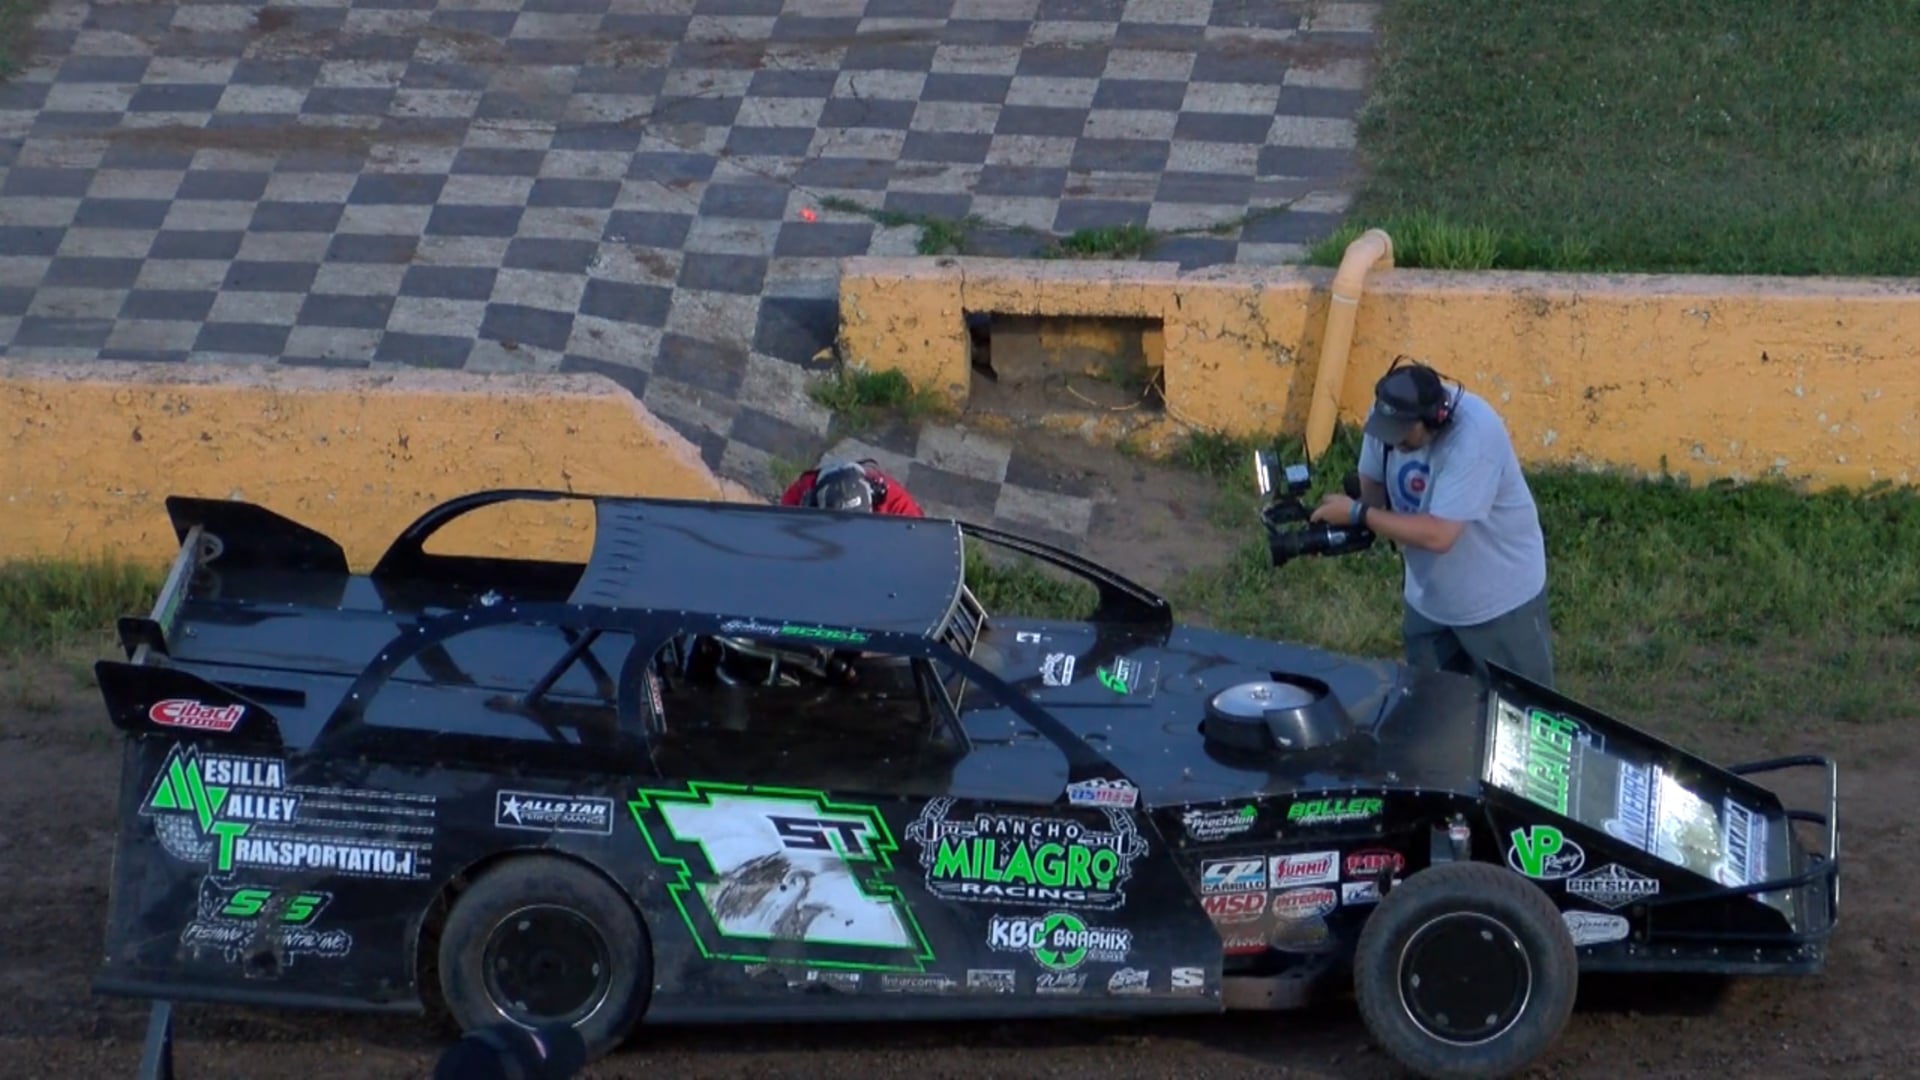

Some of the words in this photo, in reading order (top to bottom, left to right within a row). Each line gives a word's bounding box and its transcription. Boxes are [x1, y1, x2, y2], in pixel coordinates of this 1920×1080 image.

[1287, 799, 1382, 819] BOLLER
[979, 818, 1079, 840] RANCHO
[932, 837, 1119, 889] MILAGRO
[1511, 826, 1564, 879] VP
[961, 882, 1086, 900] RACING
[1204, 893, 1264, 914] MSD
[991, 919, 1047, 949] KBC
[1053, 928, 1128, 951] GRAPHIX
